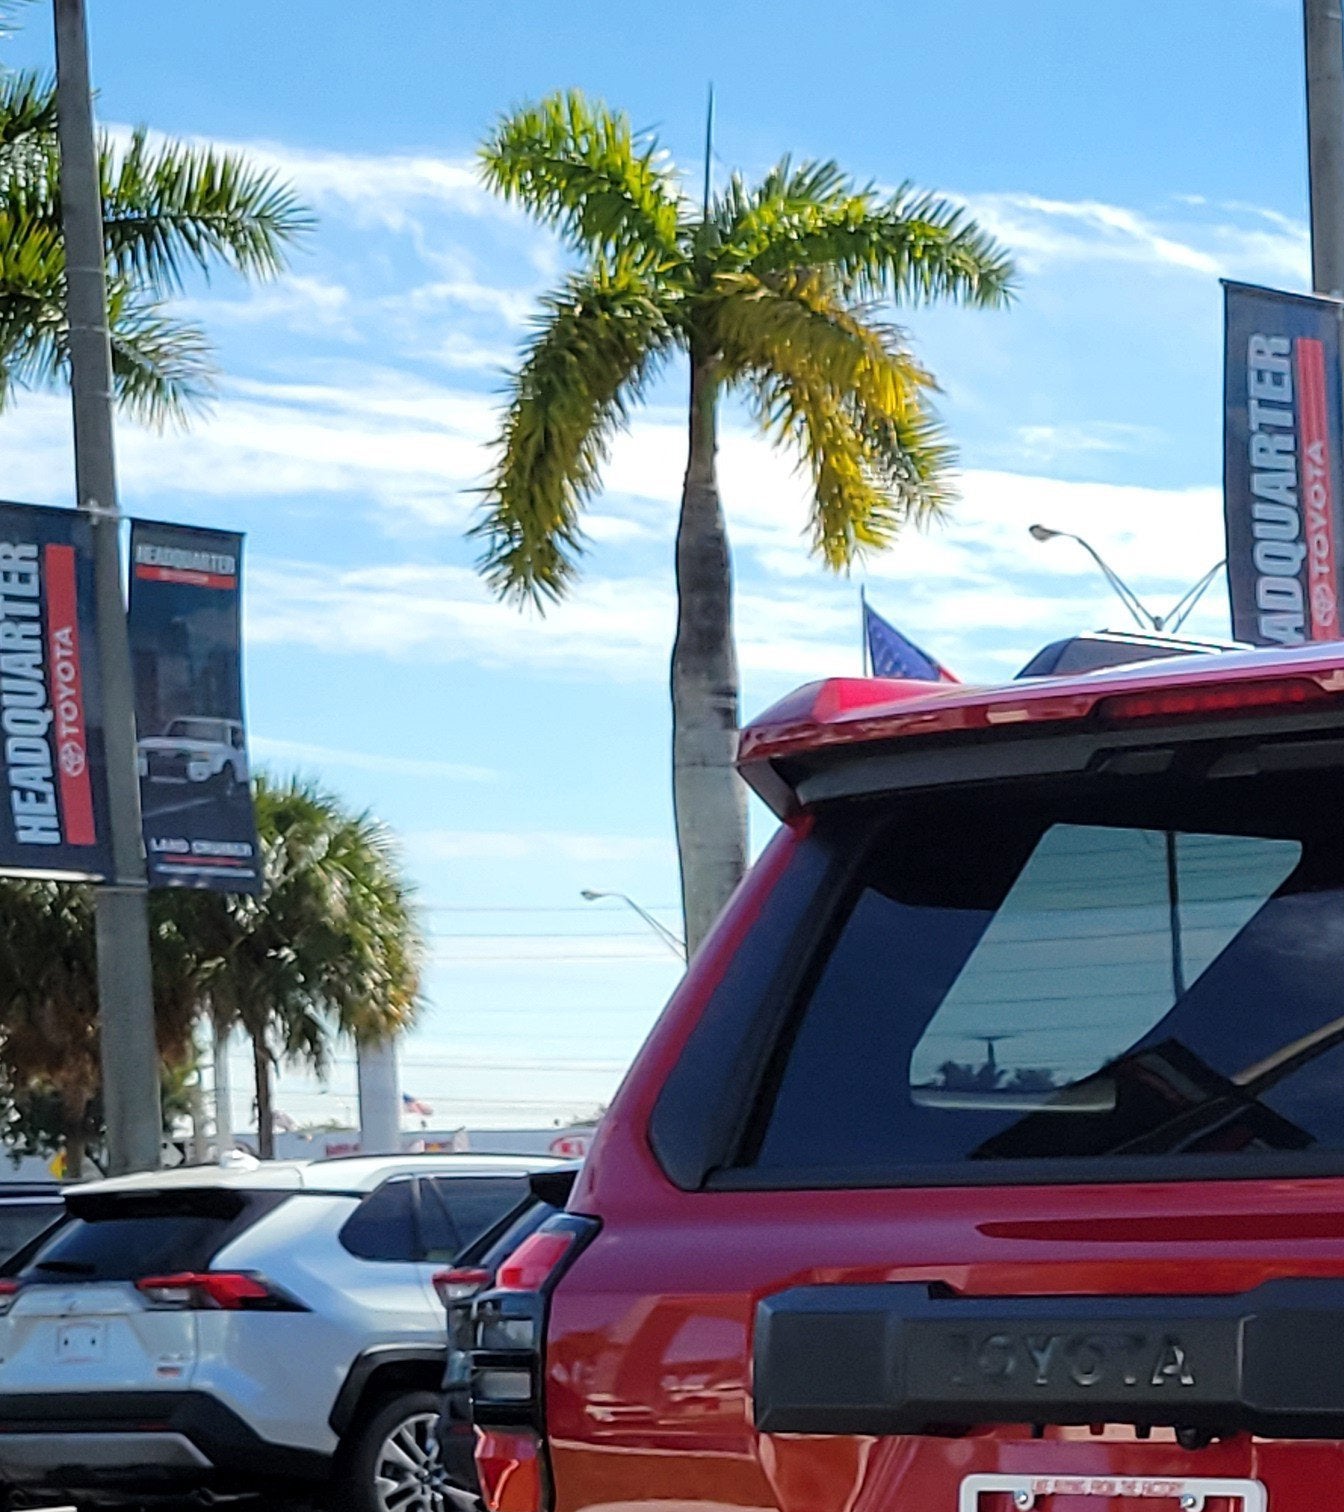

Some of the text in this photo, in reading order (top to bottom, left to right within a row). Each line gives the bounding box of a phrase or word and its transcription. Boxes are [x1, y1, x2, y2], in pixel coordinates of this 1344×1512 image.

[1249, 333, 1304, 646] ADQUARTER
[1306, 440, 1336, 575] TOYOTA
[0, 543, 61, 845] HEADQUARTER
[53, 625, 80, 738] TOYOTA
[950, 1333, 1195, 1386] TOYOTA
